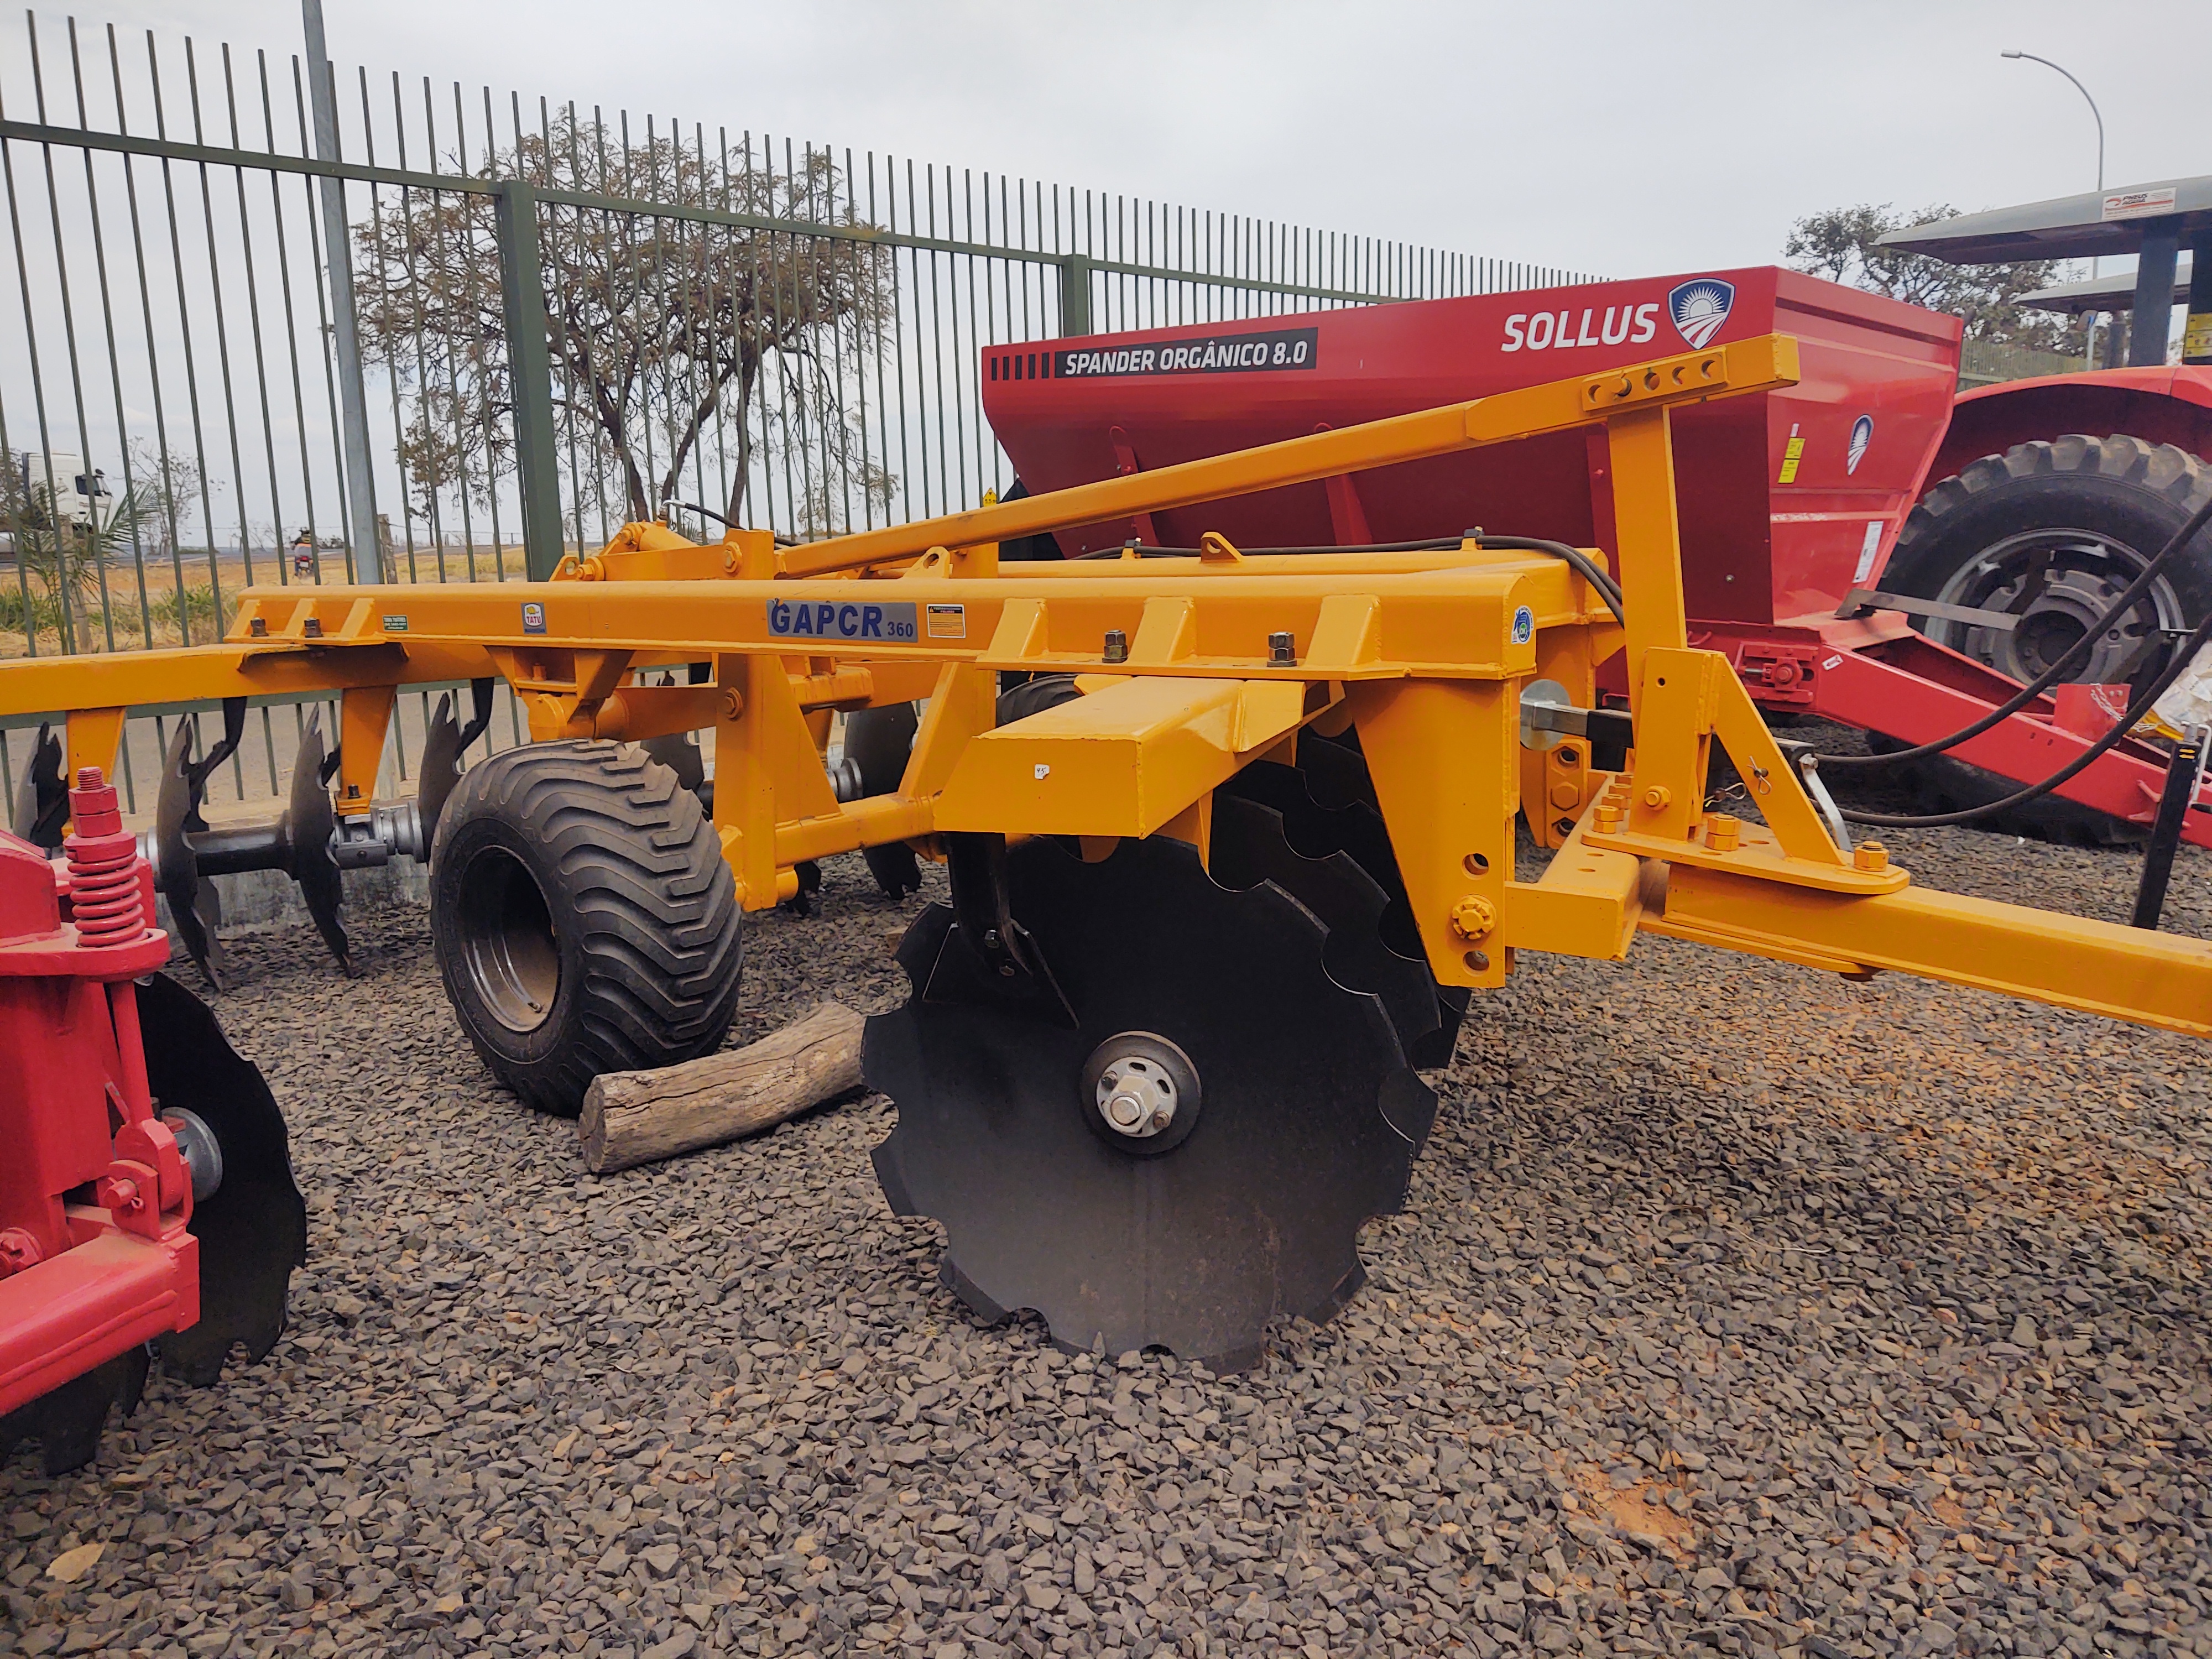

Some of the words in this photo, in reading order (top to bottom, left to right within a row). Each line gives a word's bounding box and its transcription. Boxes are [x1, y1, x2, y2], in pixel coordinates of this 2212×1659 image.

[1501, 303, 1659, 352] SOLLUS
[1065, 349, 1155, 374] SPANDER
[1160, 340, 1269, 369] ORGÂNICO
[1272, 341, 1307, 364] 8.0
[771, 604, 883, 638] GAPCR
[888, 622, 914, 637] 360
